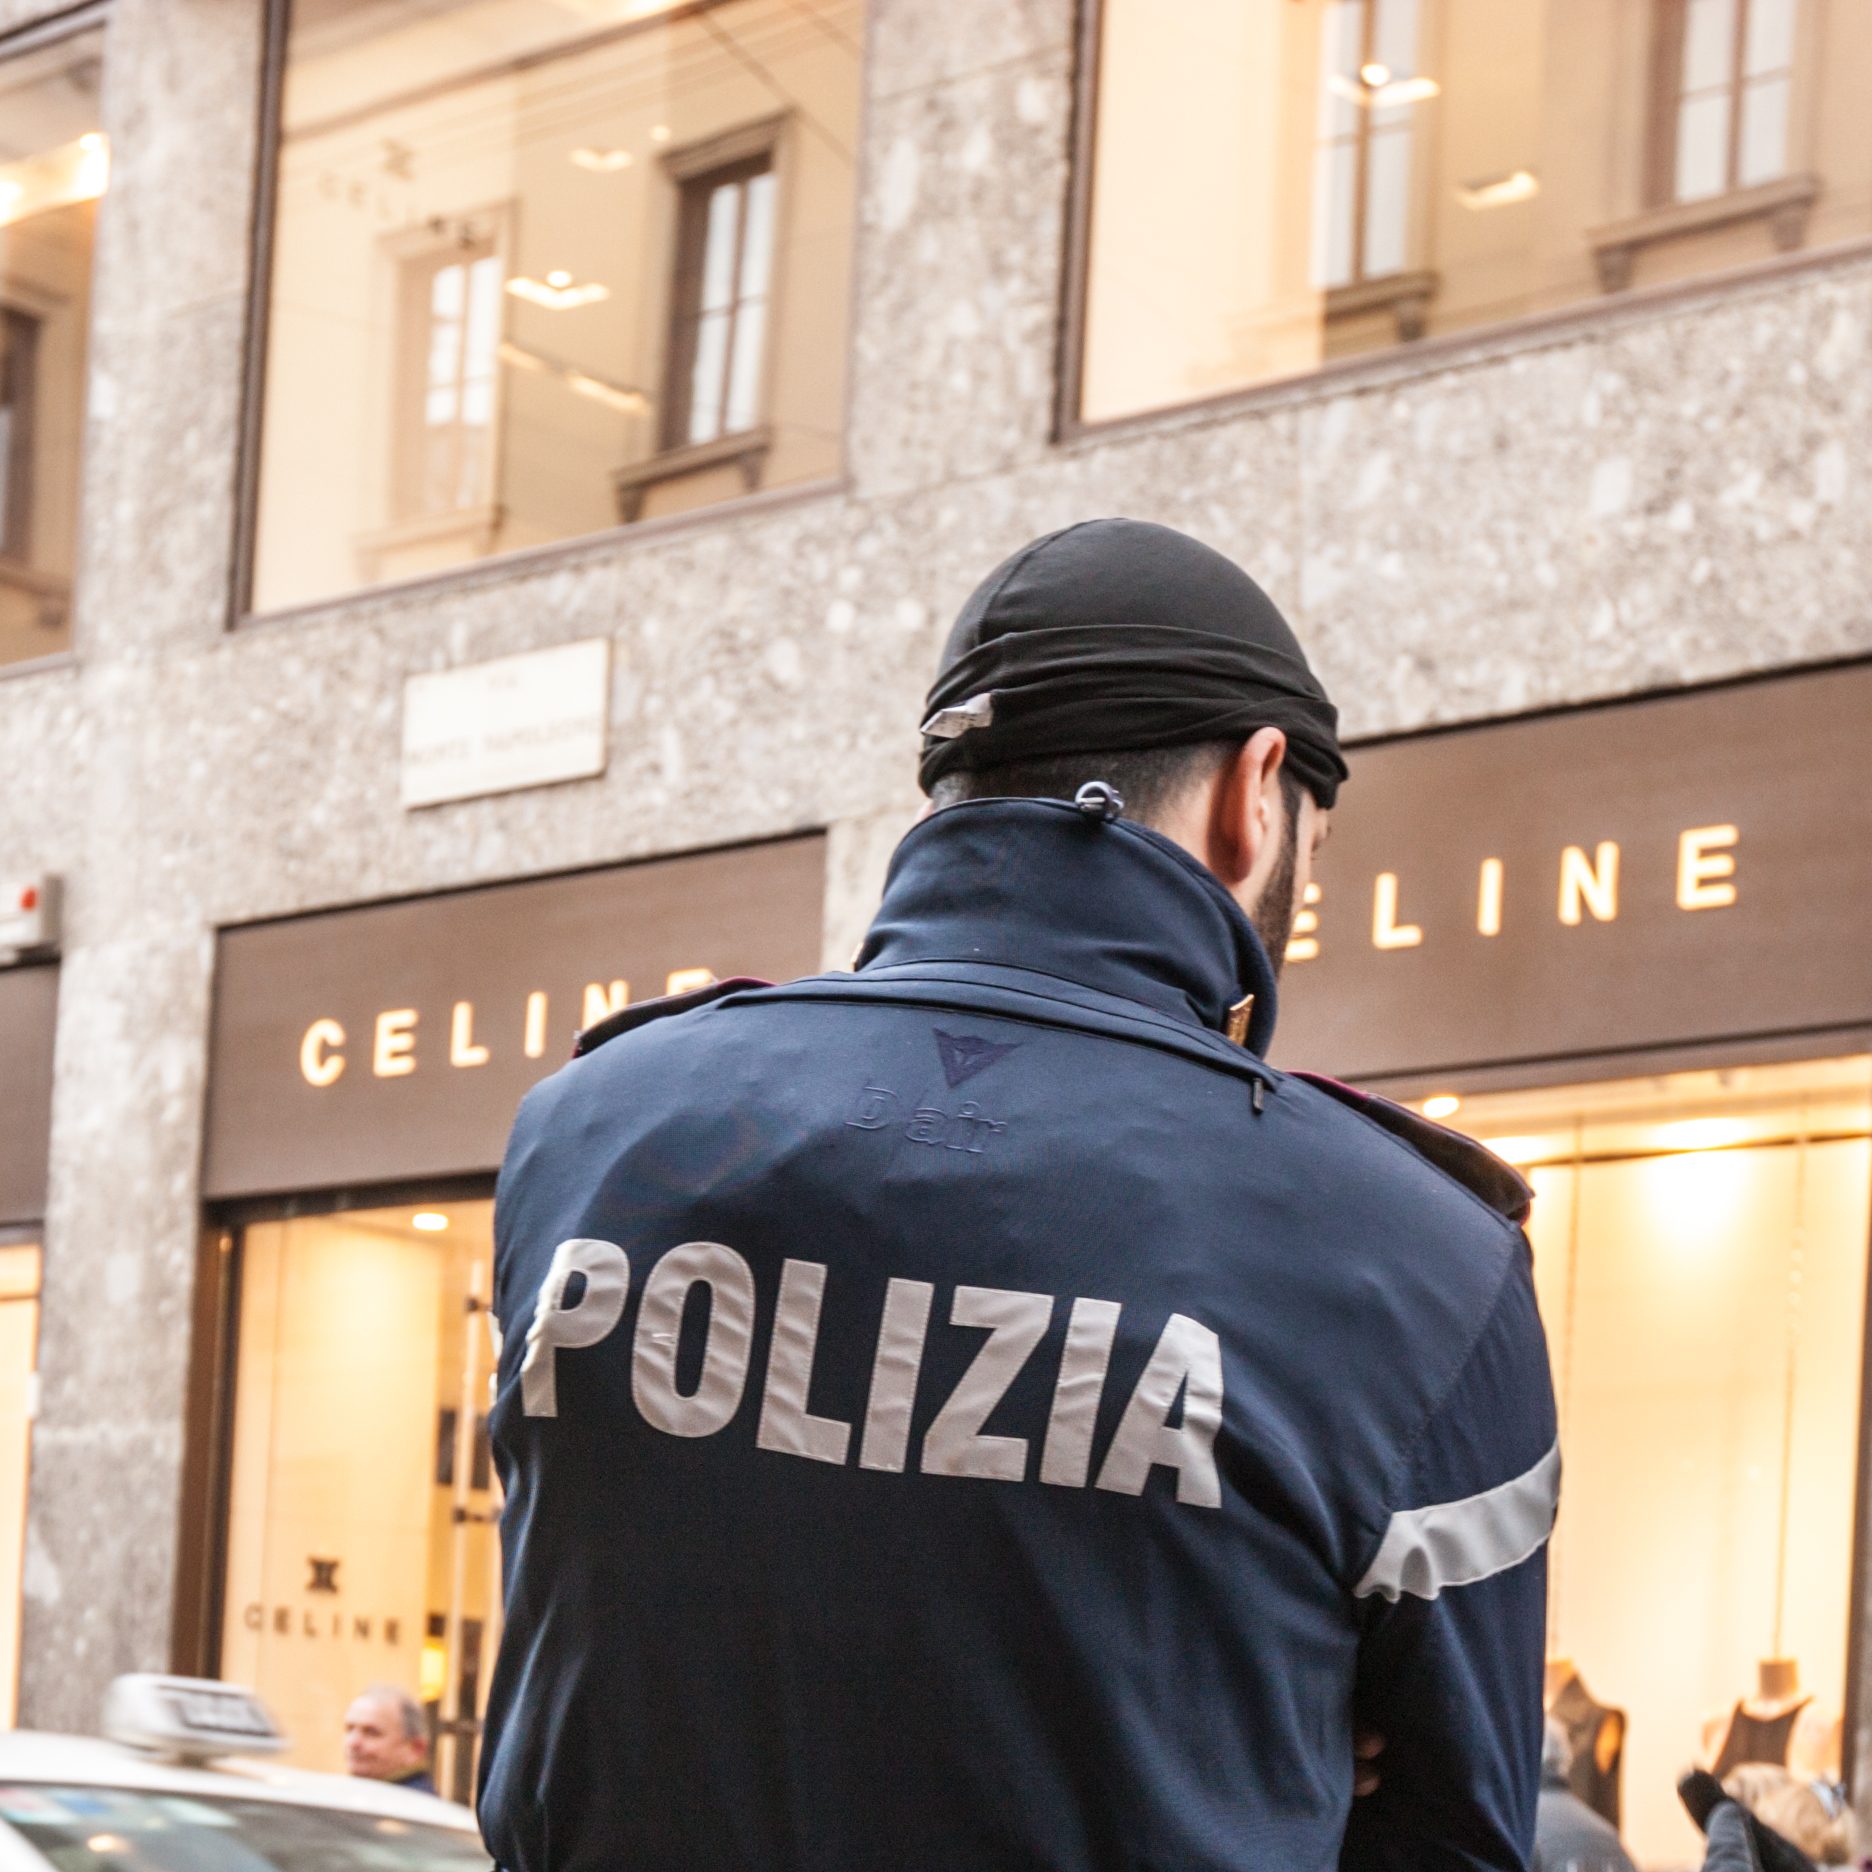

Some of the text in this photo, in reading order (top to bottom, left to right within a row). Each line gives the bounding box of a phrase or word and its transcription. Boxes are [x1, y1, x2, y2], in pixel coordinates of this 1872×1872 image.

[1285, 823, 1740, 962] ELINE
[299, 968, 715, 1087] CELIN
[521, 1238, 1224, 1510] POLIZIA
[243, 1603, 400, 1647] CELINE
